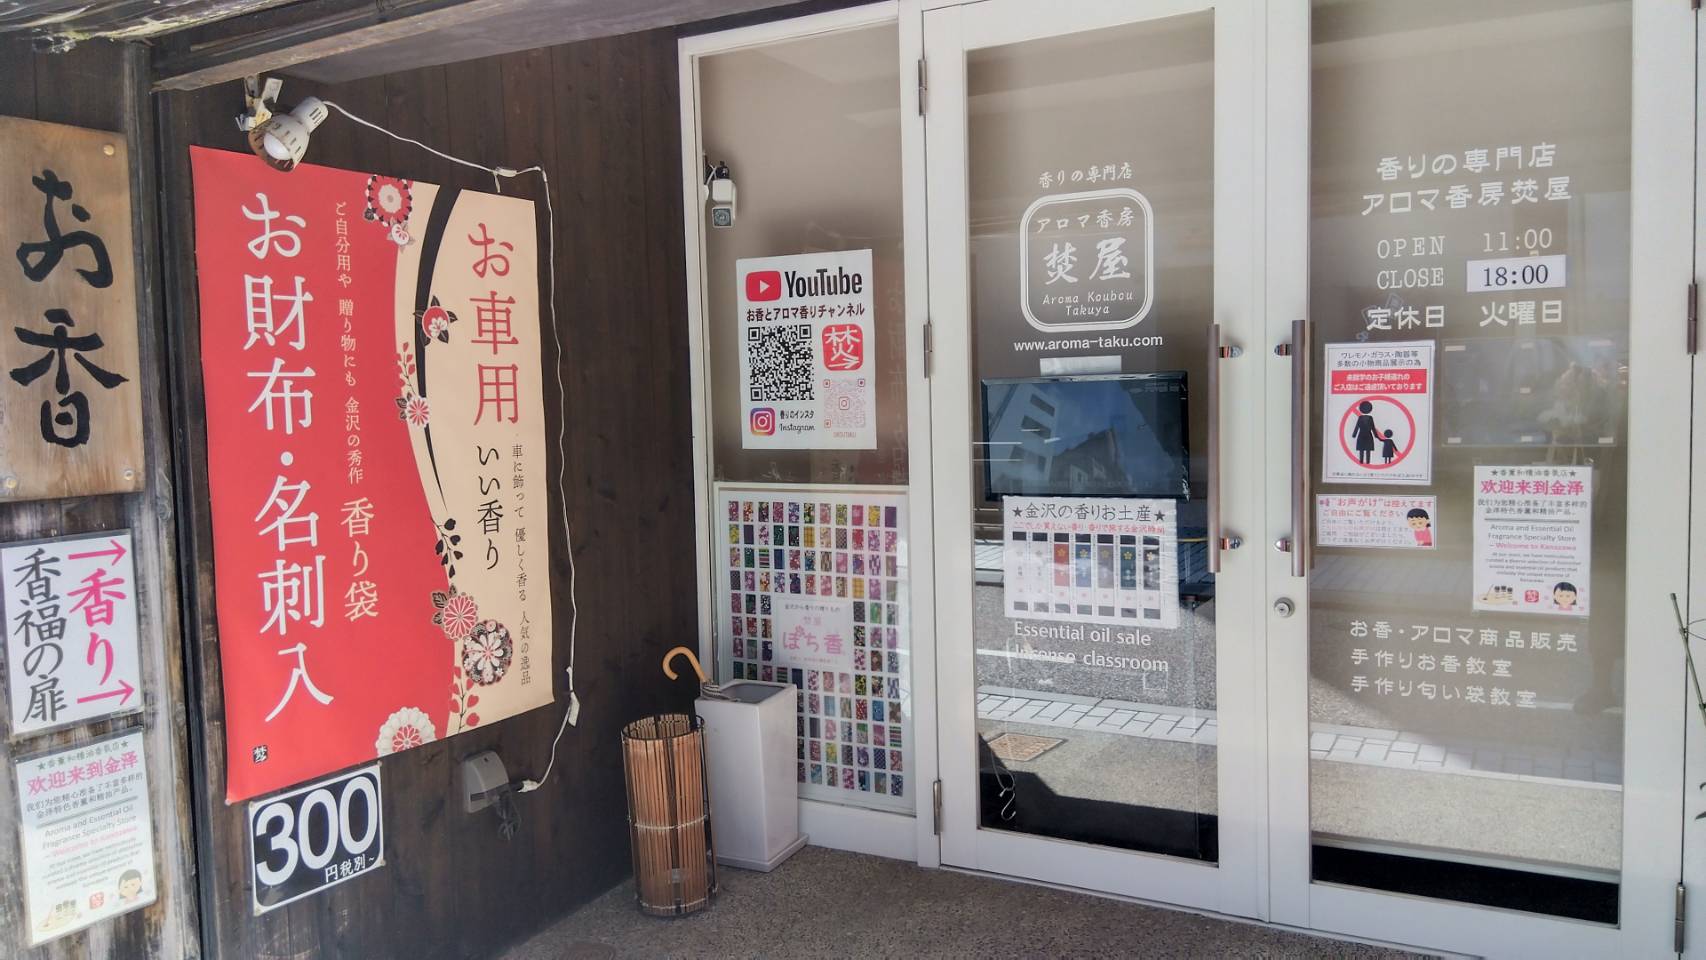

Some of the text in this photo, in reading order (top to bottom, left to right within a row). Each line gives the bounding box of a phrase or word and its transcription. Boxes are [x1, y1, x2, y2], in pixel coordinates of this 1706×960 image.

[1039, 162, 1133, 188] 香りの専門店
[1377, 143, 1556, 181] 香りの専門店
[1361, 176, 1572, 216] アロマ香房焚屋
[1036, 207, 1135, 233] アロマ香房
[1377, 228, 1552, 259] OPEN 11:00
[1043, 237, 1131, 285] 焚屋
[1377, 264, 1549, 290] CLOSE 18:00
[784, 266, 863, 298] YouTube
[1042, 291, 1133, 305] Aroma Koubou
[9, 169, 129, 448] お香
[746, 303, 865, 322] お香とアロマ香りチャンネル
[1066, 305, 1110, 317] Takuya
[1366, 300, 1562, 331] 定休日 火曜日
[339, 299, 358, 387] 贈り物にも
[1014, 335, 1163, 351] www.aroma-taku.com
[467, 223, 519, 571] お車用 いい香り
[345, 397, 364, 484] 金沢の秀作
[779, 423, 816, 434] Instagram
[241, 192, 334, 722] お財布・名刺入
[512, 443, 525, 518] 車に飾って
[1025, 502, 1152, 522] 金沢の香りお土産
[340, 497, 378, 622] 香り袋
[515, 527, 528, 602] 優しく香る
[13, 548, 68, 723] 香福の扉
[67, 568, 126, 686] 香り
[1014, 621, 1151, 646] Essential oil sale
[1350, 620, 1578, 652] お香・アロマ商品販売
[1083, 650, 1168, 672] classroom
[1351, 648, 1513, 678] 手作りお香教室
[1351, 675, 1537, 708] 手作り匂い袋教室
[256, 776, 378, 886] 300
